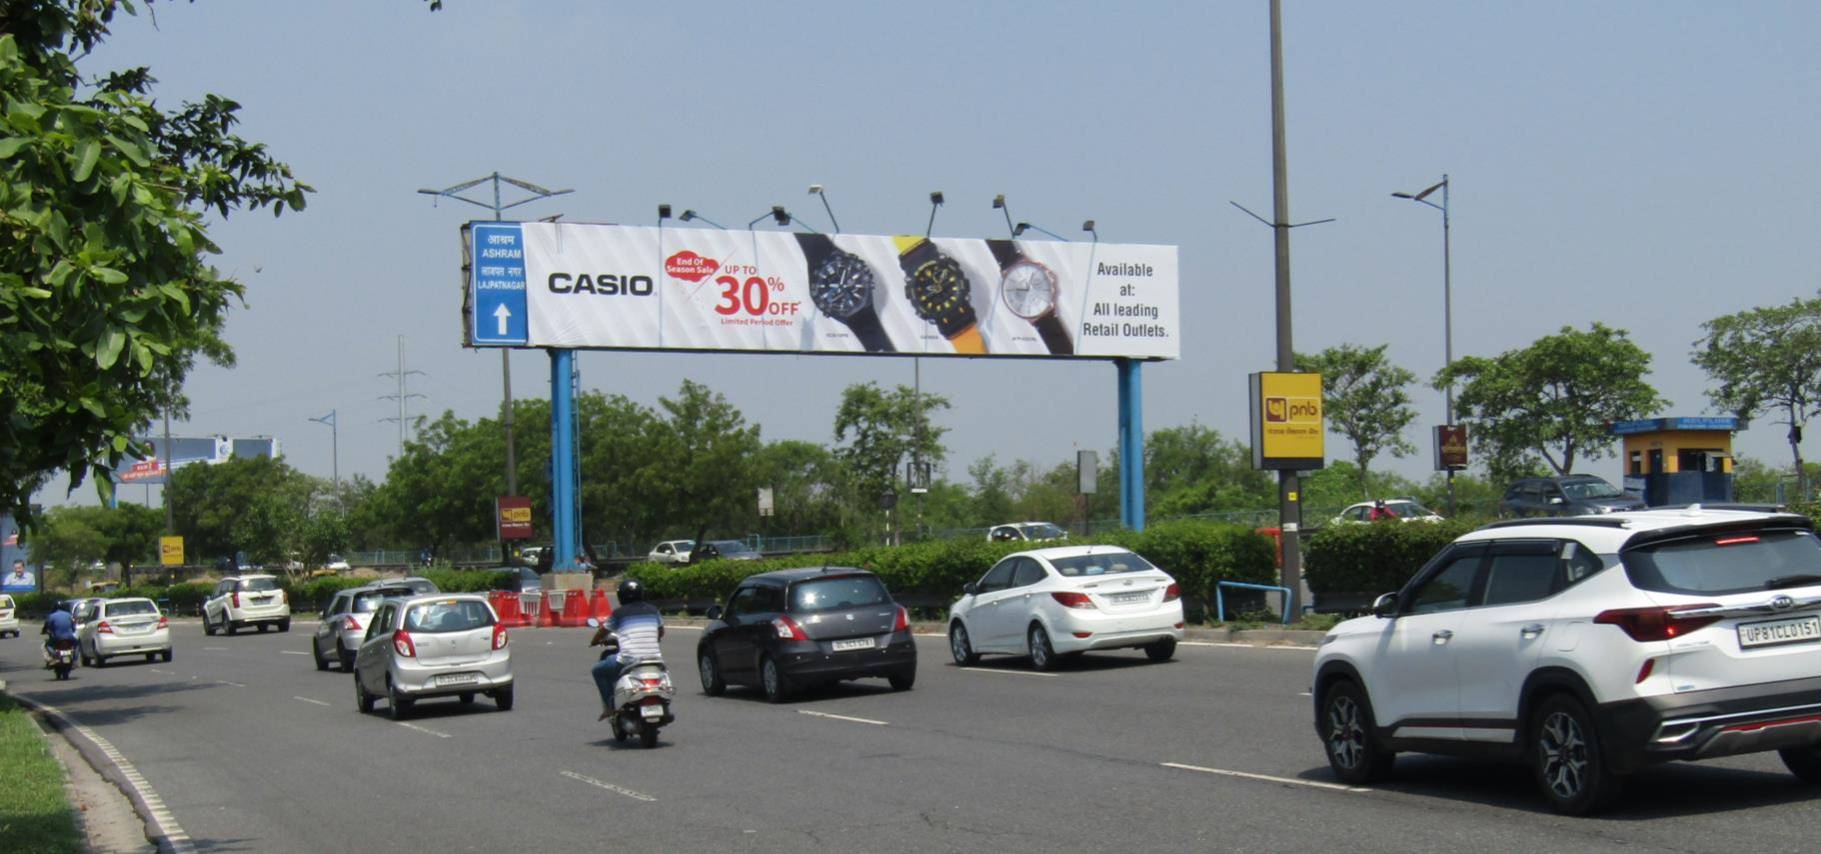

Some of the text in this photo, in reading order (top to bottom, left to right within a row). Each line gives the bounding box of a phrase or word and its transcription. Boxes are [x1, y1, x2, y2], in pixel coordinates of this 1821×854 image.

[488, 234, 515, 245] आश्रम
[482, 248, 521, 258] ASHRAM
[676, 258, 703, 266] End Of
[507, 266, 522, 277] नगर
[667, 265, 714, 274] Season Sale
[725, 265, 757, 275] UP TO
[1097, 262, 1153, 277] Available
[478, 281, 525, 289] LAJPATNAGAR
[548, 272, 653, 296] CASIO
[1120, 284, 1135, 296] at:
[1094, 302, 1158, 320] All leading
[721, 318, 748, 326] Limited
[750, 319, 774, 327] Period
[1083, 322, 1169, 337] Retail Outlets.
[1289, 401, 1318, 420] pnb
[1747, 622, 1819, 642] UP81CL0151
